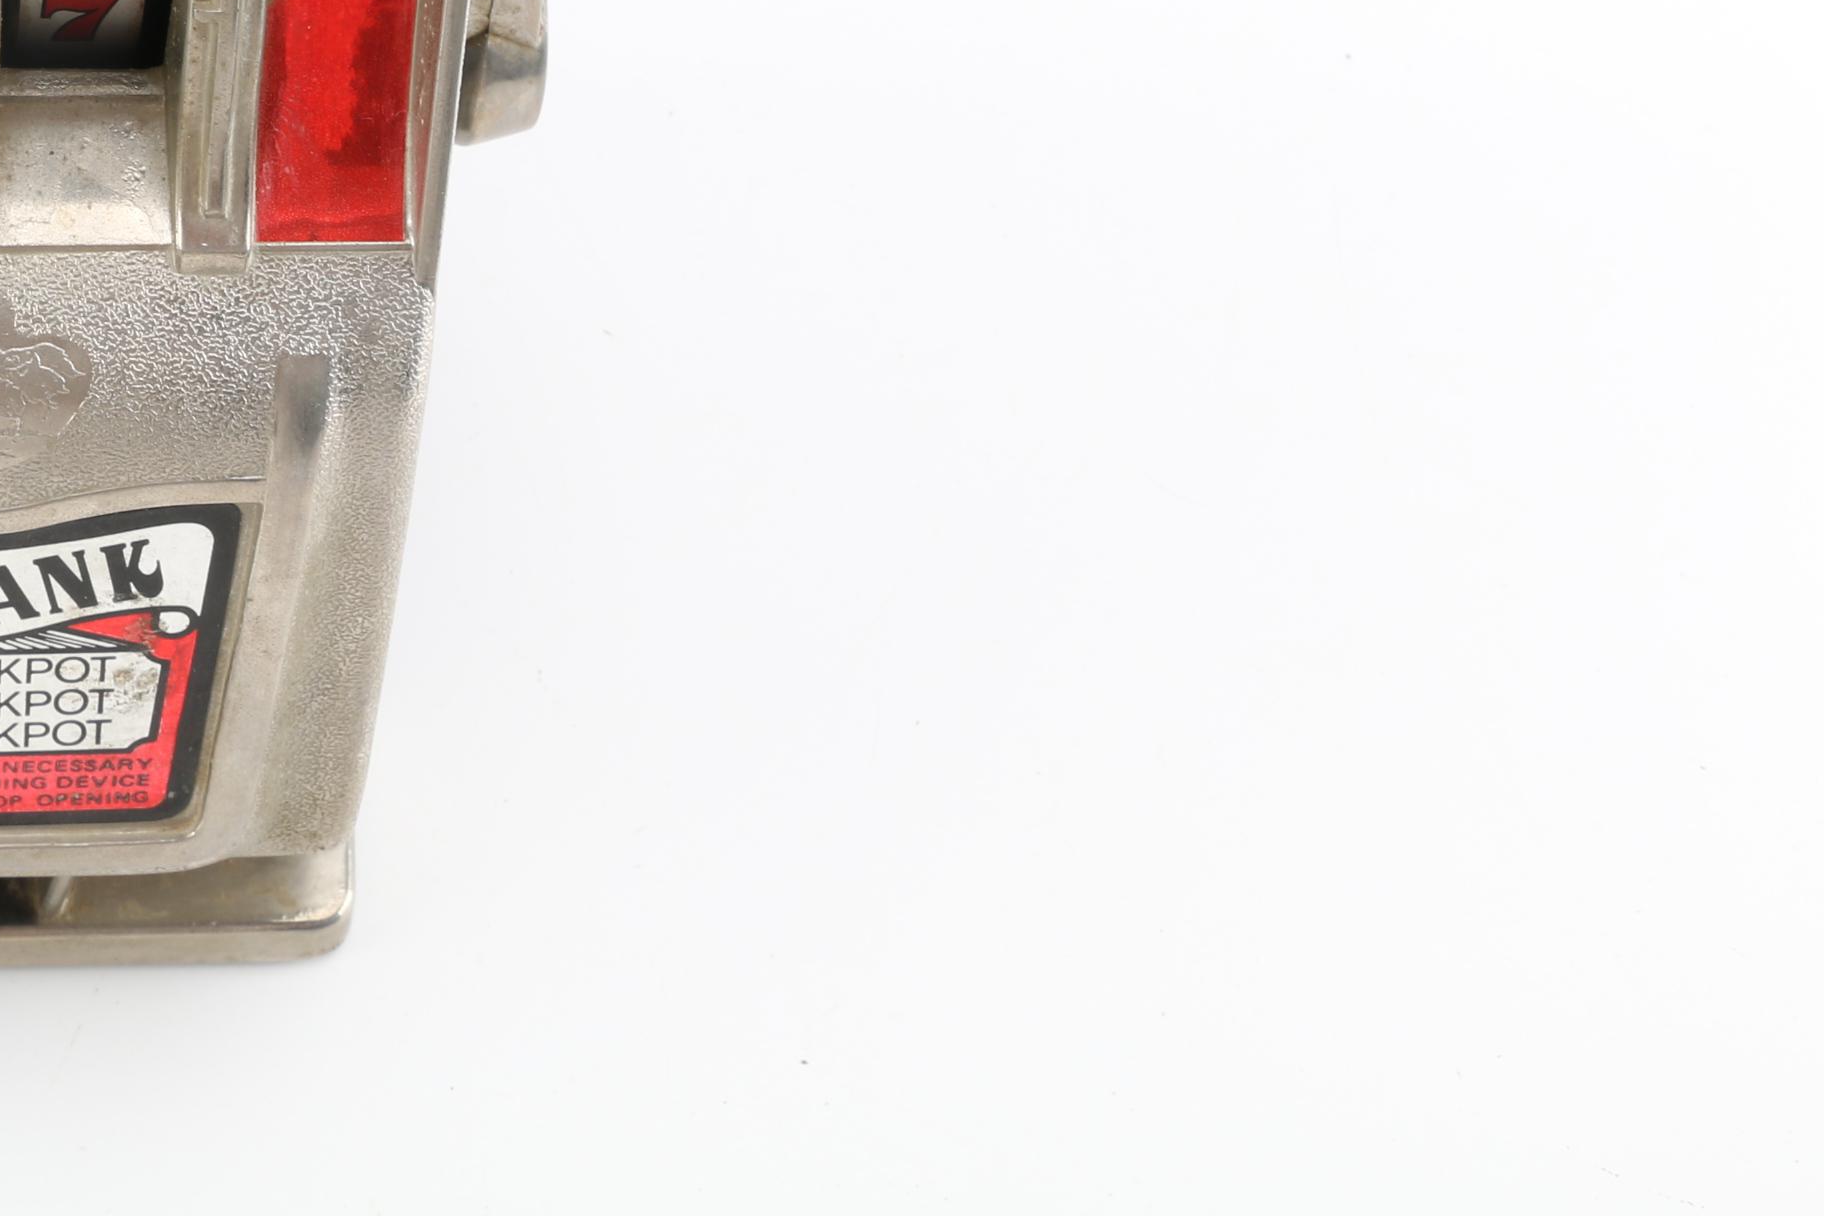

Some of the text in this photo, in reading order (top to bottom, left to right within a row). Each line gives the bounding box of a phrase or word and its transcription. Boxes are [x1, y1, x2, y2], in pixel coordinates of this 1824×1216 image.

[2, 757, 154, 774] NECESSARY
[56, 774, 151, 789] DEVICE
[36, 790, 149, 807] OPENING
